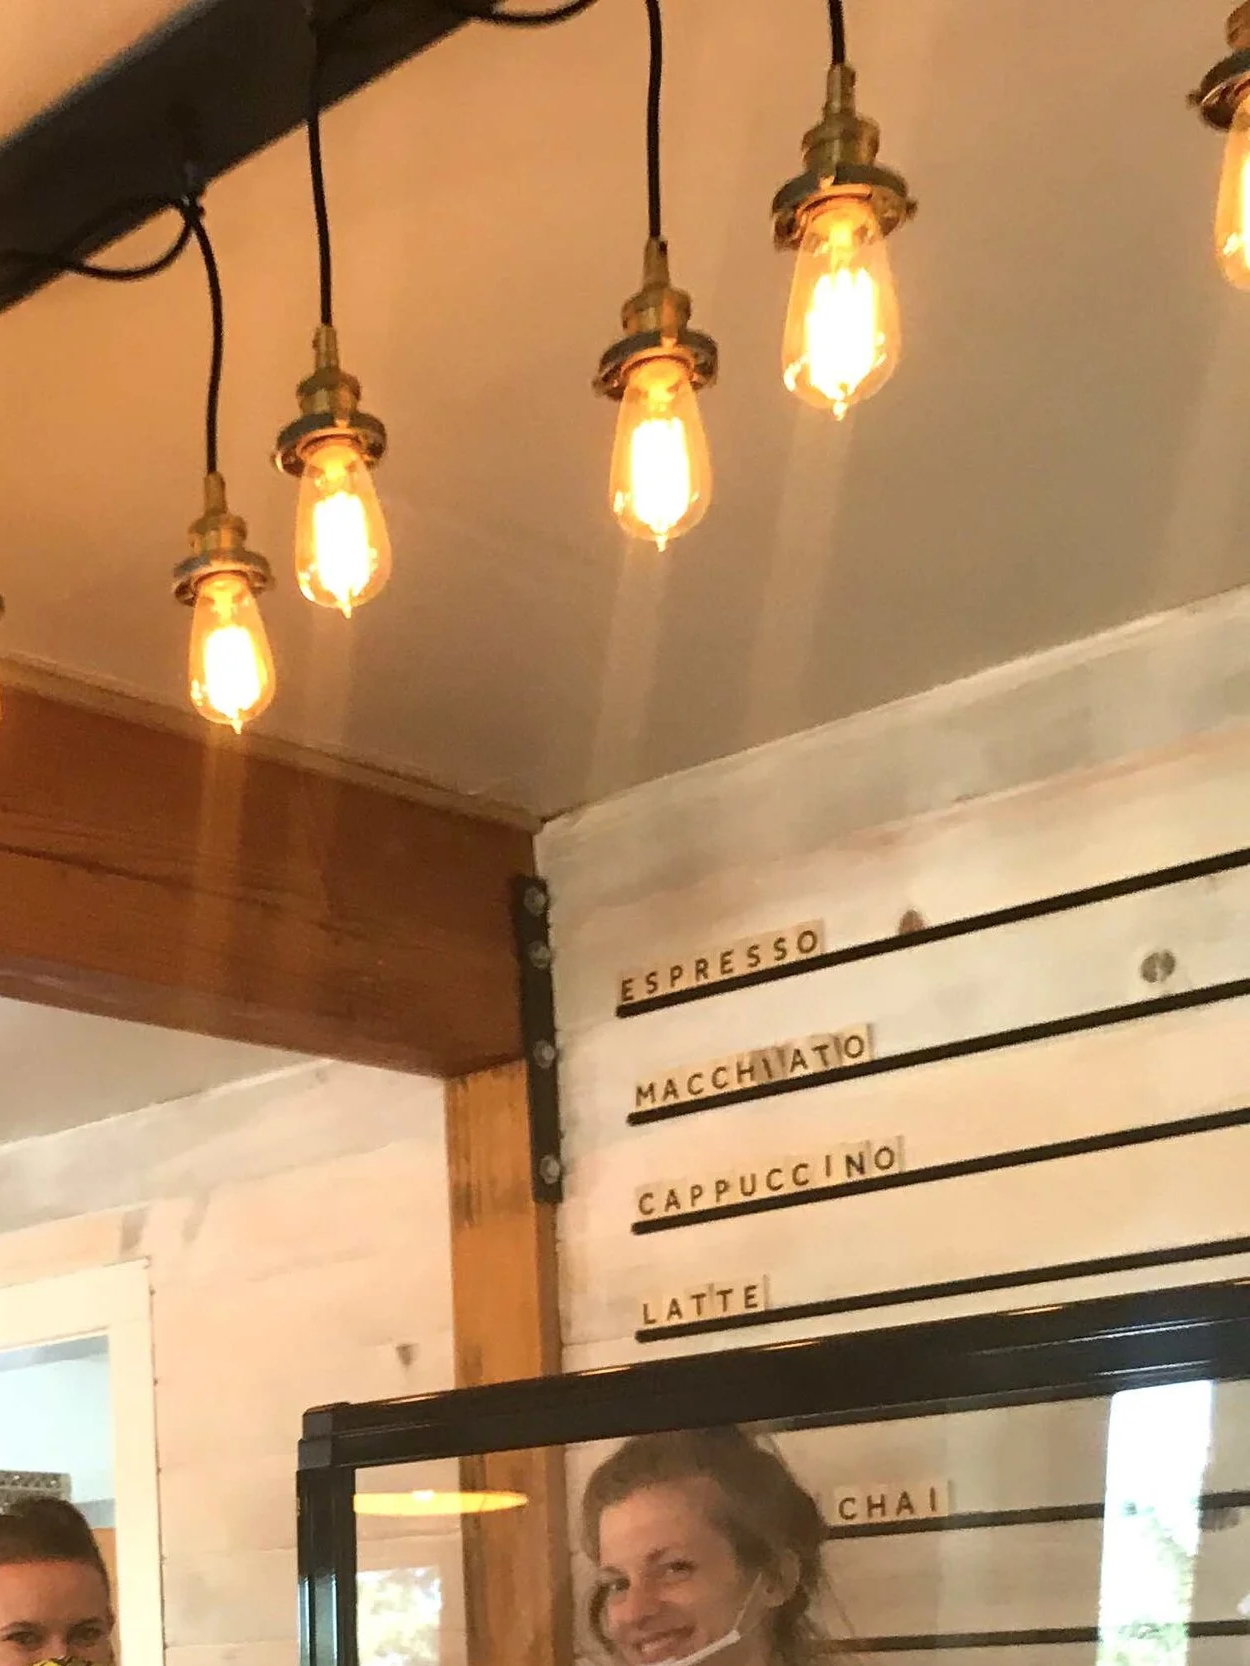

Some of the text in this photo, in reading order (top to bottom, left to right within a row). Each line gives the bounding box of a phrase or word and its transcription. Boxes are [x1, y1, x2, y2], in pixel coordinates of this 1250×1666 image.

[621, 930, 818, 1001] ESPRESSO
[635, 1035, 865, 1107] MACCHIATO
[638, 1146, 896, 1215] CAPPUCCINO
[642, 1284, 758, 1325] LATTE
[838, 1486, 938, 1521] CHAI
